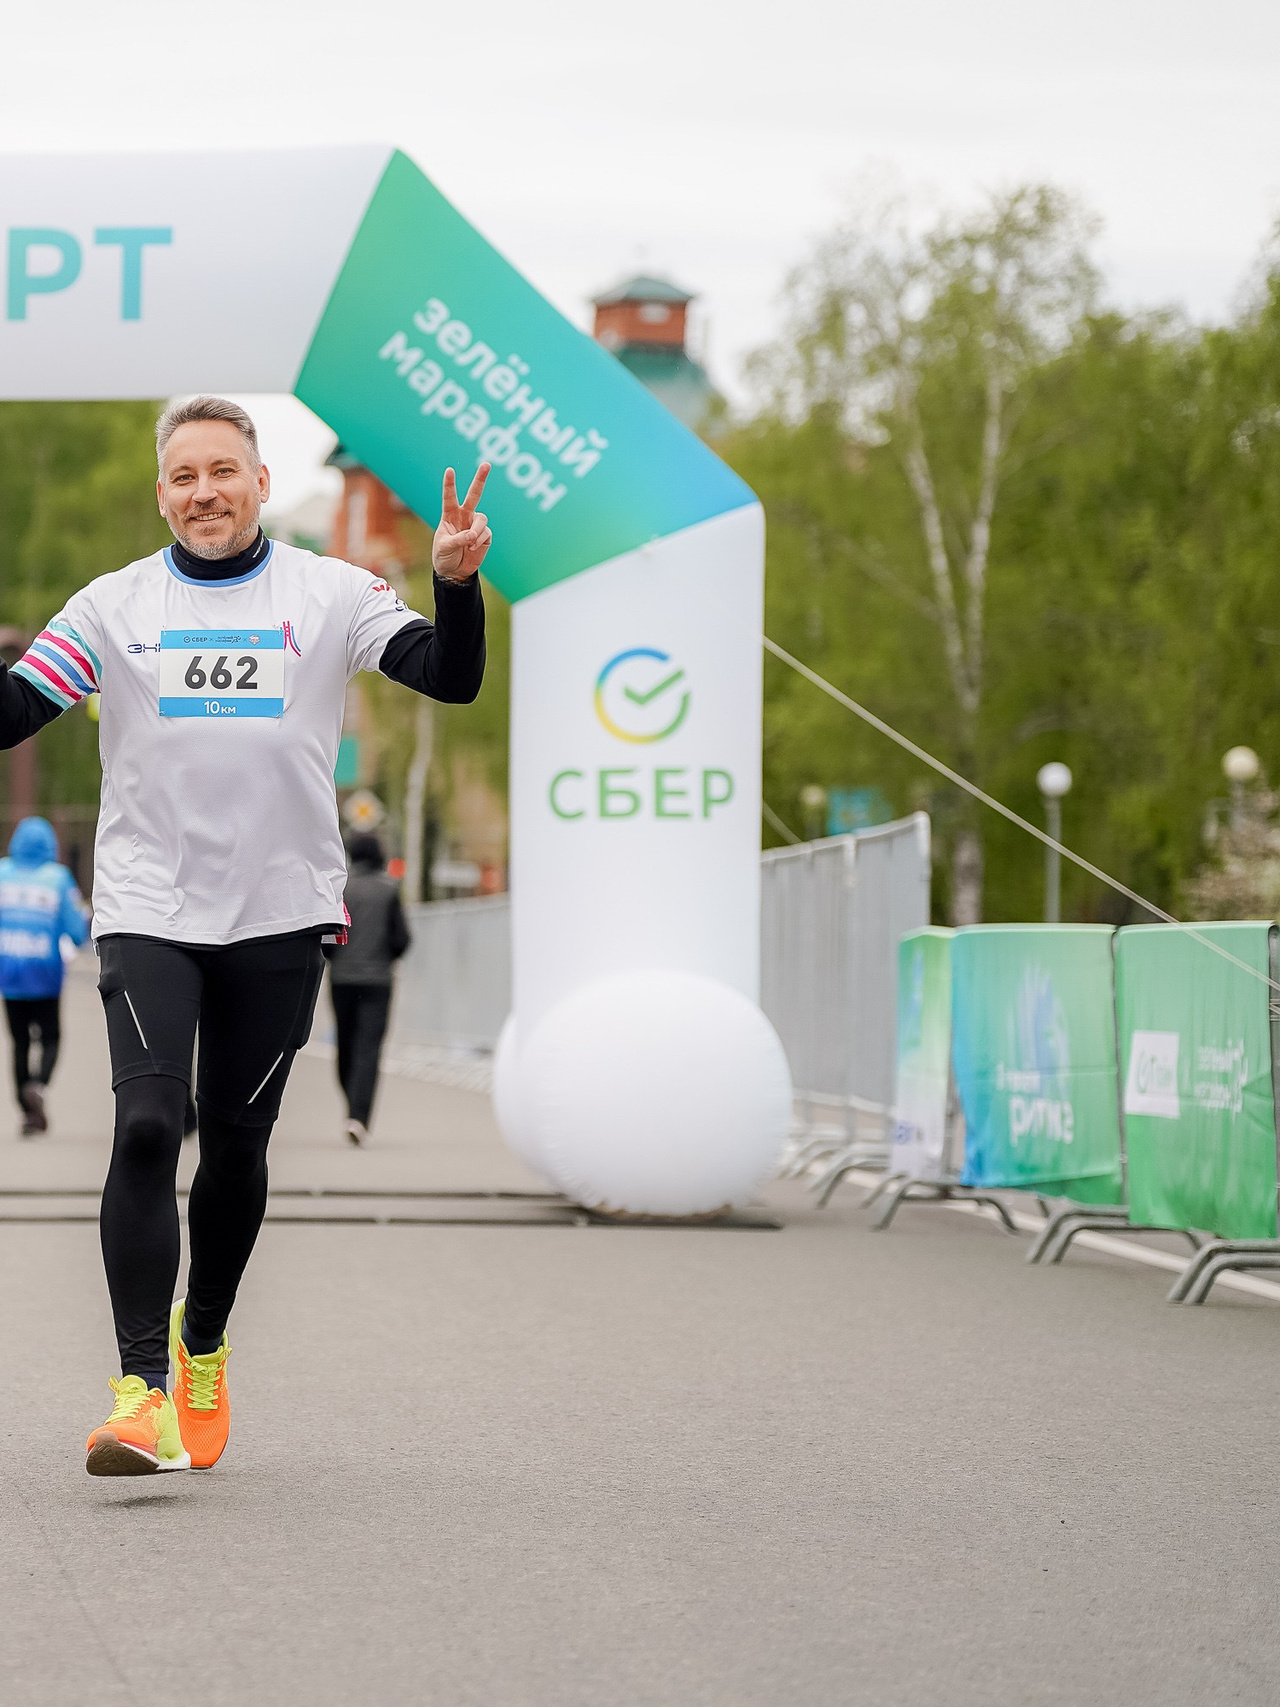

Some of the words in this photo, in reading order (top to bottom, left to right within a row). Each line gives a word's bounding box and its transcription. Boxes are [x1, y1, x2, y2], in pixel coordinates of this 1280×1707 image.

[378, 330, 568, 512] марафон
[412, 297, 609, 479] зелёный
[184, 655, 259, 690] 662
[549, 768, 735, 819] СБЕР
